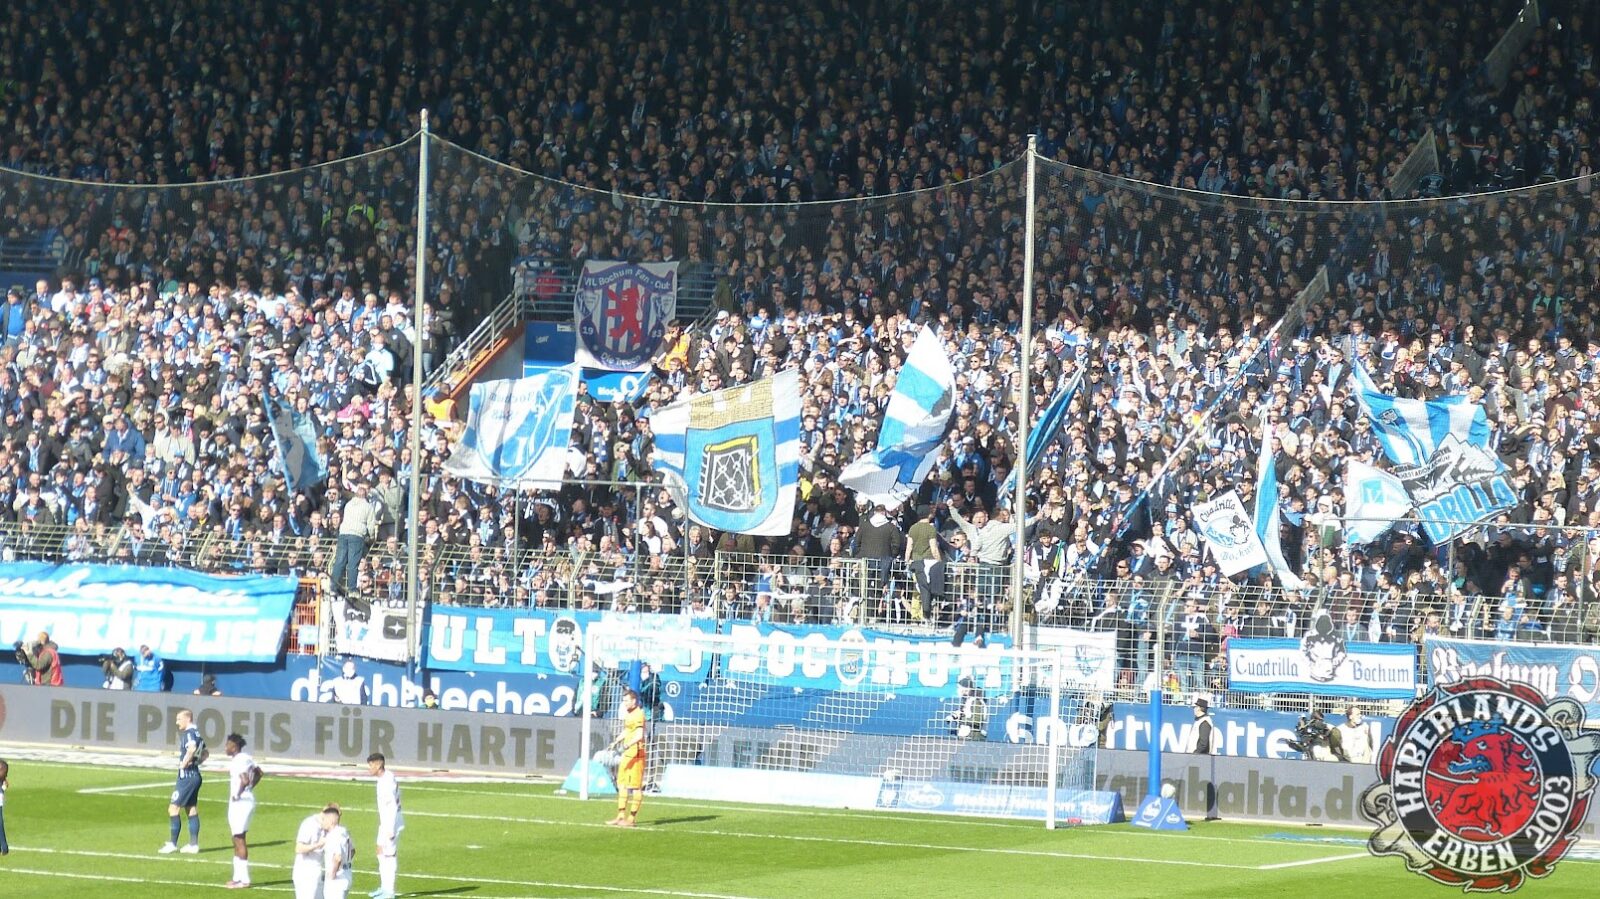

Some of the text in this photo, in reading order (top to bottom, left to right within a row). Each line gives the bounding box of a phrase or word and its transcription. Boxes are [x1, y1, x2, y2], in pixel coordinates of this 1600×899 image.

[599, 268, 633, 286] Bochum
[1200, 499, 1236, 523] Cuadrilla
[1235, 654, 1409, 683] Cuadrilla Bochum
[50, 699, 115, 742] DIE
[315, 707, 395, 760] FÜR
[417, 721, 556, 769] HARTE
